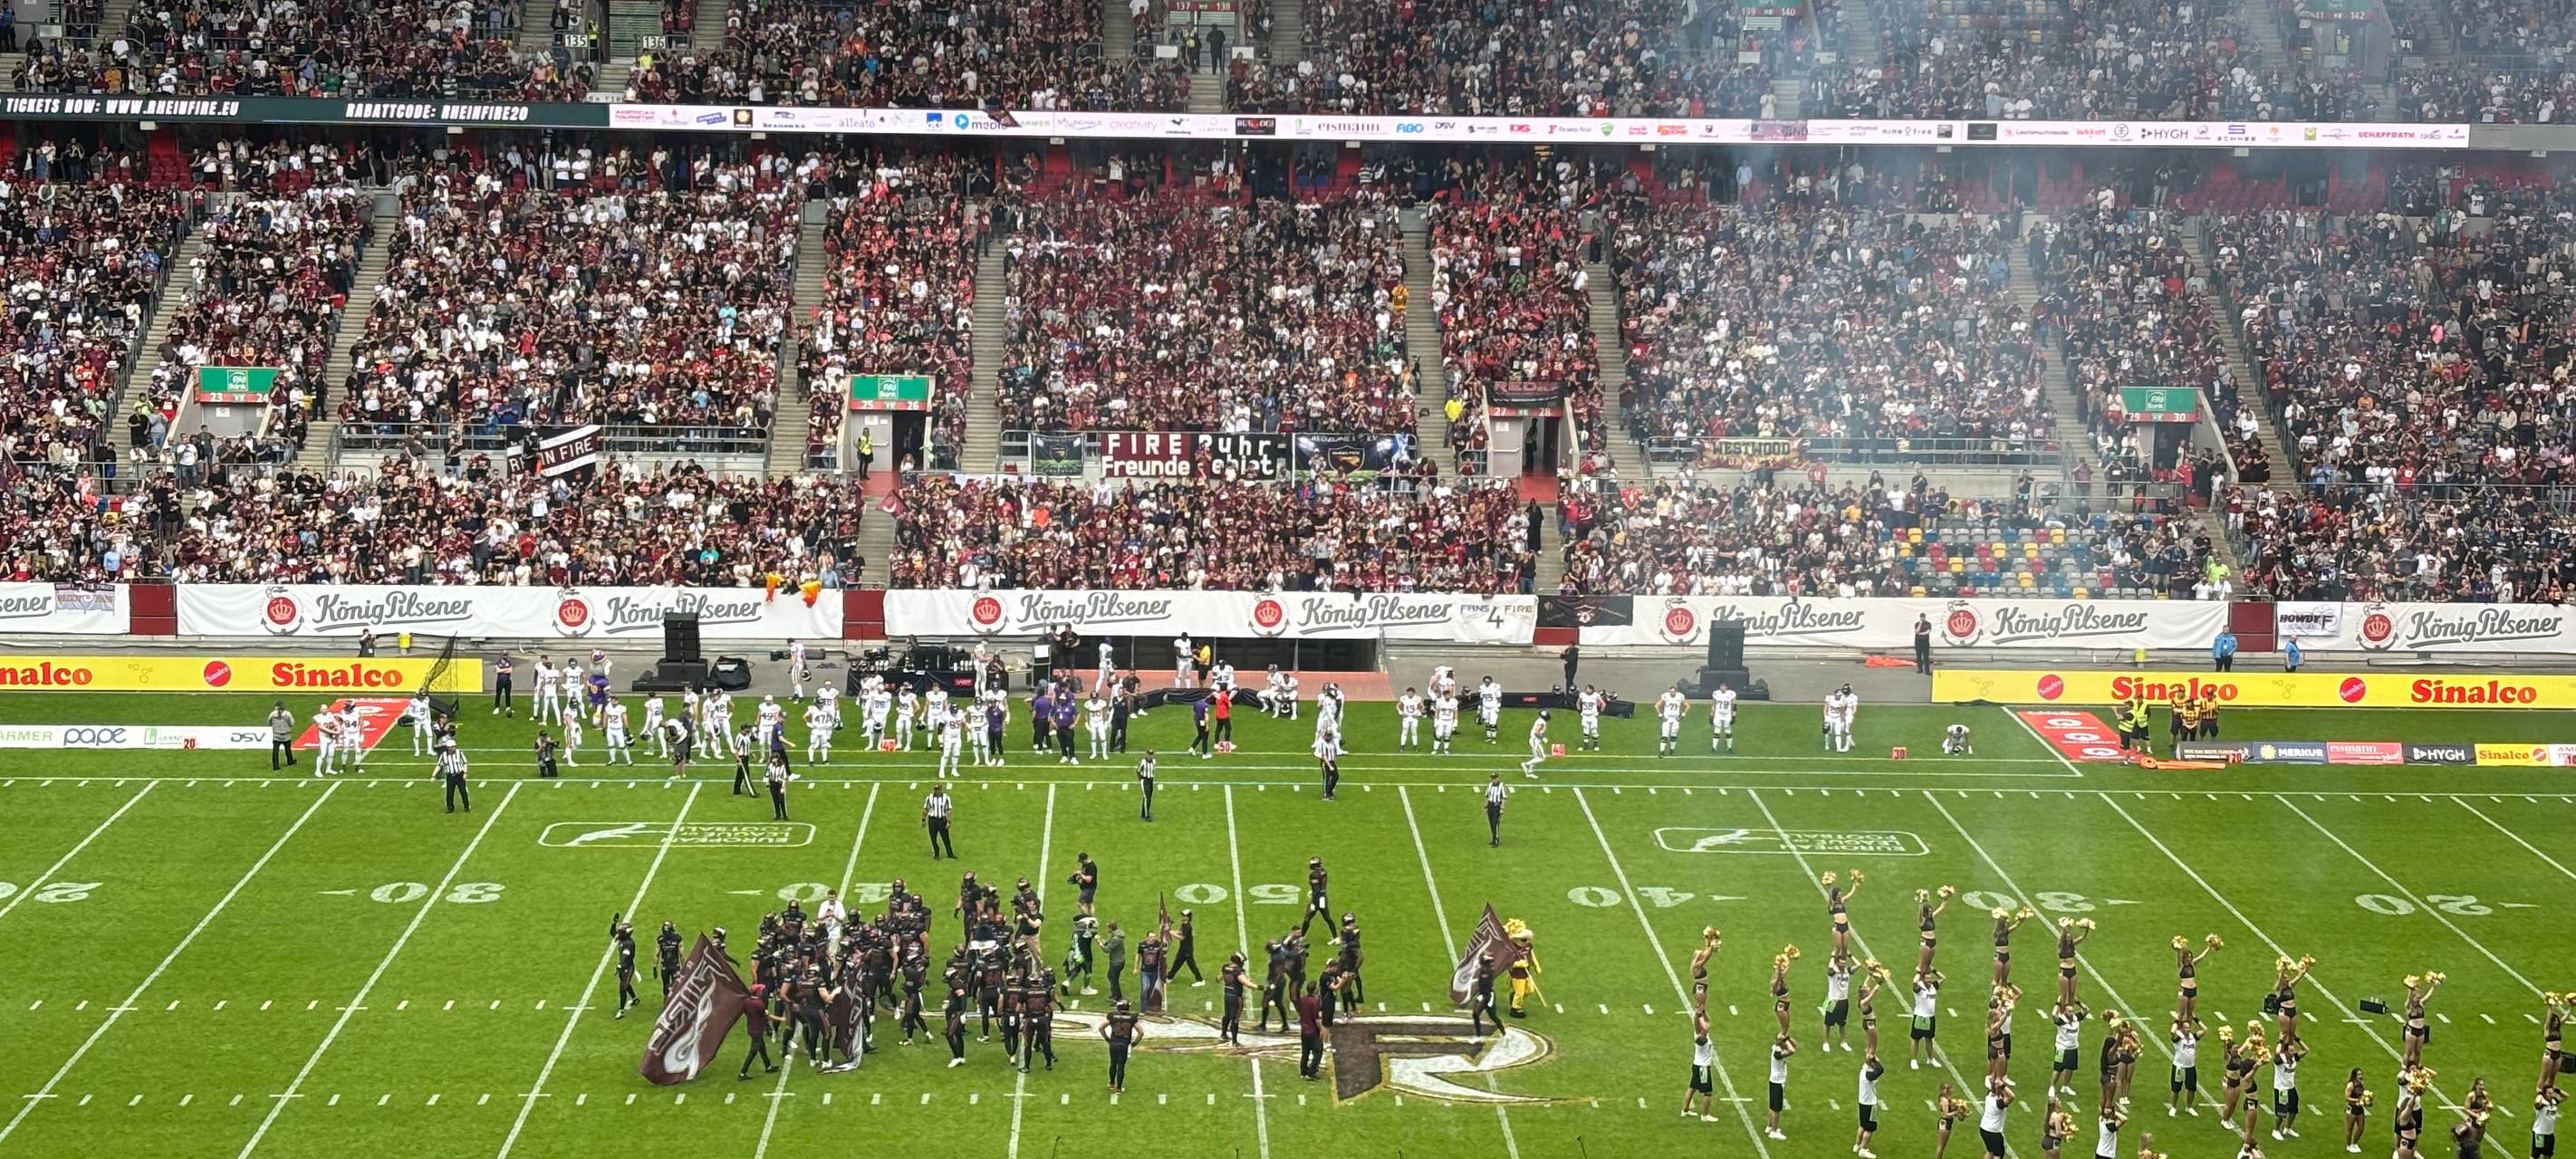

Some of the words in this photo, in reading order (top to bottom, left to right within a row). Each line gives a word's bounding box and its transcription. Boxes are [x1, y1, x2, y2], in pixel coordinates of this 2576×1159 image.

[1177, 2, 1190, 11] 137
[1216, 2, 1230, 11] 138
[567, 35, 586, 47] 135
[644, 36, 666, 48] 136
[6, 99, 60, 113] TICKETS
[64, 99, 101, 113] NOW:
[106, 100, 239, 116] WWW.RHEINFIRE.EU
[345, 103, 436, 120] RABATTCODE:
[441, 104, 529, 121] RHEINFIRE20
[839, 118, 875, 129] alleato
[1318, 122, 1380, 132] eismann
[2154, 129, 2188, 139] HYGH
[210, 392, 223, 402] 23
[256, 392, 269, 402] 24
[861, 400, 874, 409] 25
[907, 400, 919, 409] 26
[1495, 407, 1506, 417] 27
[1539, 407, 1552, 417] 28
[2173, 413, 2186, 421] 30
[559, 436, 594, 461] FIRE
[1108, 434, 1182, 456] FIRE
[1713, 441, 1790, 455] WESTWOOD
[1102, 455, 1190, 477] Freunde
[312, 594, 384, 627] König
[386, 591, 473, 618] Pilsener
[1017, 594, 1087, 625] König
[1087, 592, 1172, 618] Pilsener
[1298, 598, 1367, 627] König
[1368, 595, 1452, 620] Pilsener
[1460, 605, 1490, 614] FANS
[1487, 606, 1504, 628] 4
[1504, 605, 1533, 614] FIRE
[1714, 605, 1778, 636] Knig
[1780, 602, 1865, 628] Pilsener
[1991, 607, 2061, 637] König
[2062, 604, 2148, 631] Pilsener
[2280, 614, 2321, 624] HOWDY
[2406, 611, 2477, 643] König
[2477, 608, 2563, 635] Pilsener
[272, 662, 403, 687] Sinalco
[2111, 676, 2238, 701] Sinalco
[2411, 679, 2537, 704] Sinalco
[1718, 700, 1729, 710] 78
[814, 714, 826, 724] 47
[972, 714, 984, 723] 23
[63, 728, 128, 746] pape
[230, 732, 266, 744] DSV
[184, 738, 197, 750] 20
[2330, 744, 2378, 753] eismann
[2278, 748, 2323, 757] MERKUR
[2428, 749, 2465, 761] HYGH
[2479, 749, 2530, 760] Sinalco
[370, 881, 506, 904] 30
[1175, 883, 1302, 905] 50
[1567, 886, 1695, 908] 40
[1962, 890, 2097, 913] 30
[2355, 893, 2493, 916] 20
